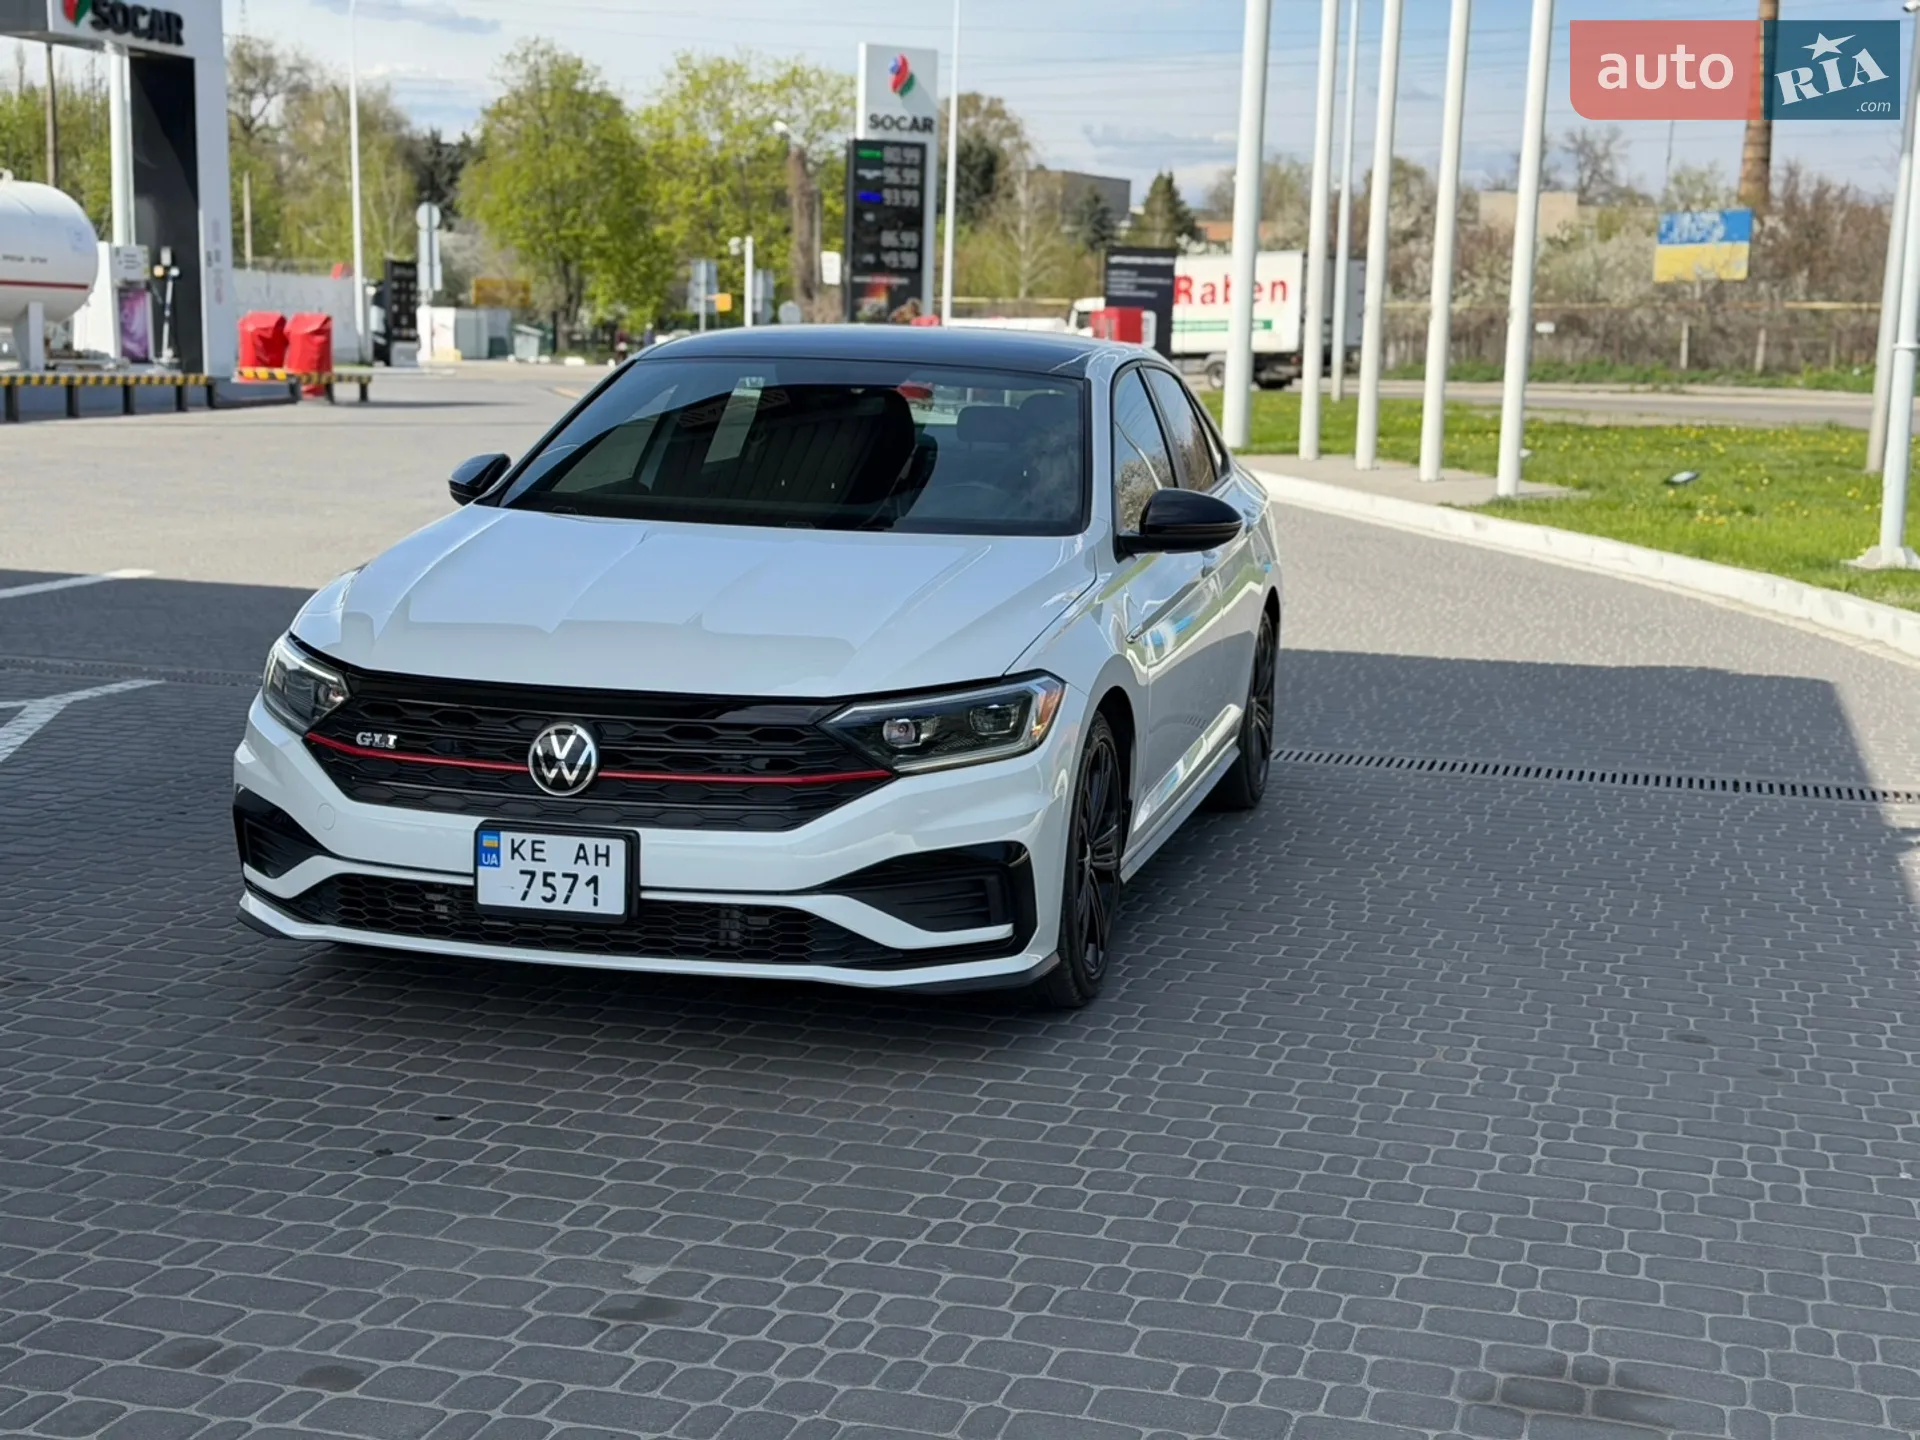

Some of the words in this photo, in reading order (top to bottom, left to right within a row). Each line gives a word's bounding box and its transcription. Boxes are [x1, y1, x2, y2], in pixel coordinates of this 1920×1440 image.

[90, 0, 184, 47] SOCAR
[868, 113, 934, 134] SOCAR
[356, 731, 398, 749] GLI
[481, 853, 499, 866] UA
[510, 838, 547, 863] KE
[573, 842, 610, 867] AH
[518, 869, 600, 907] 7571
